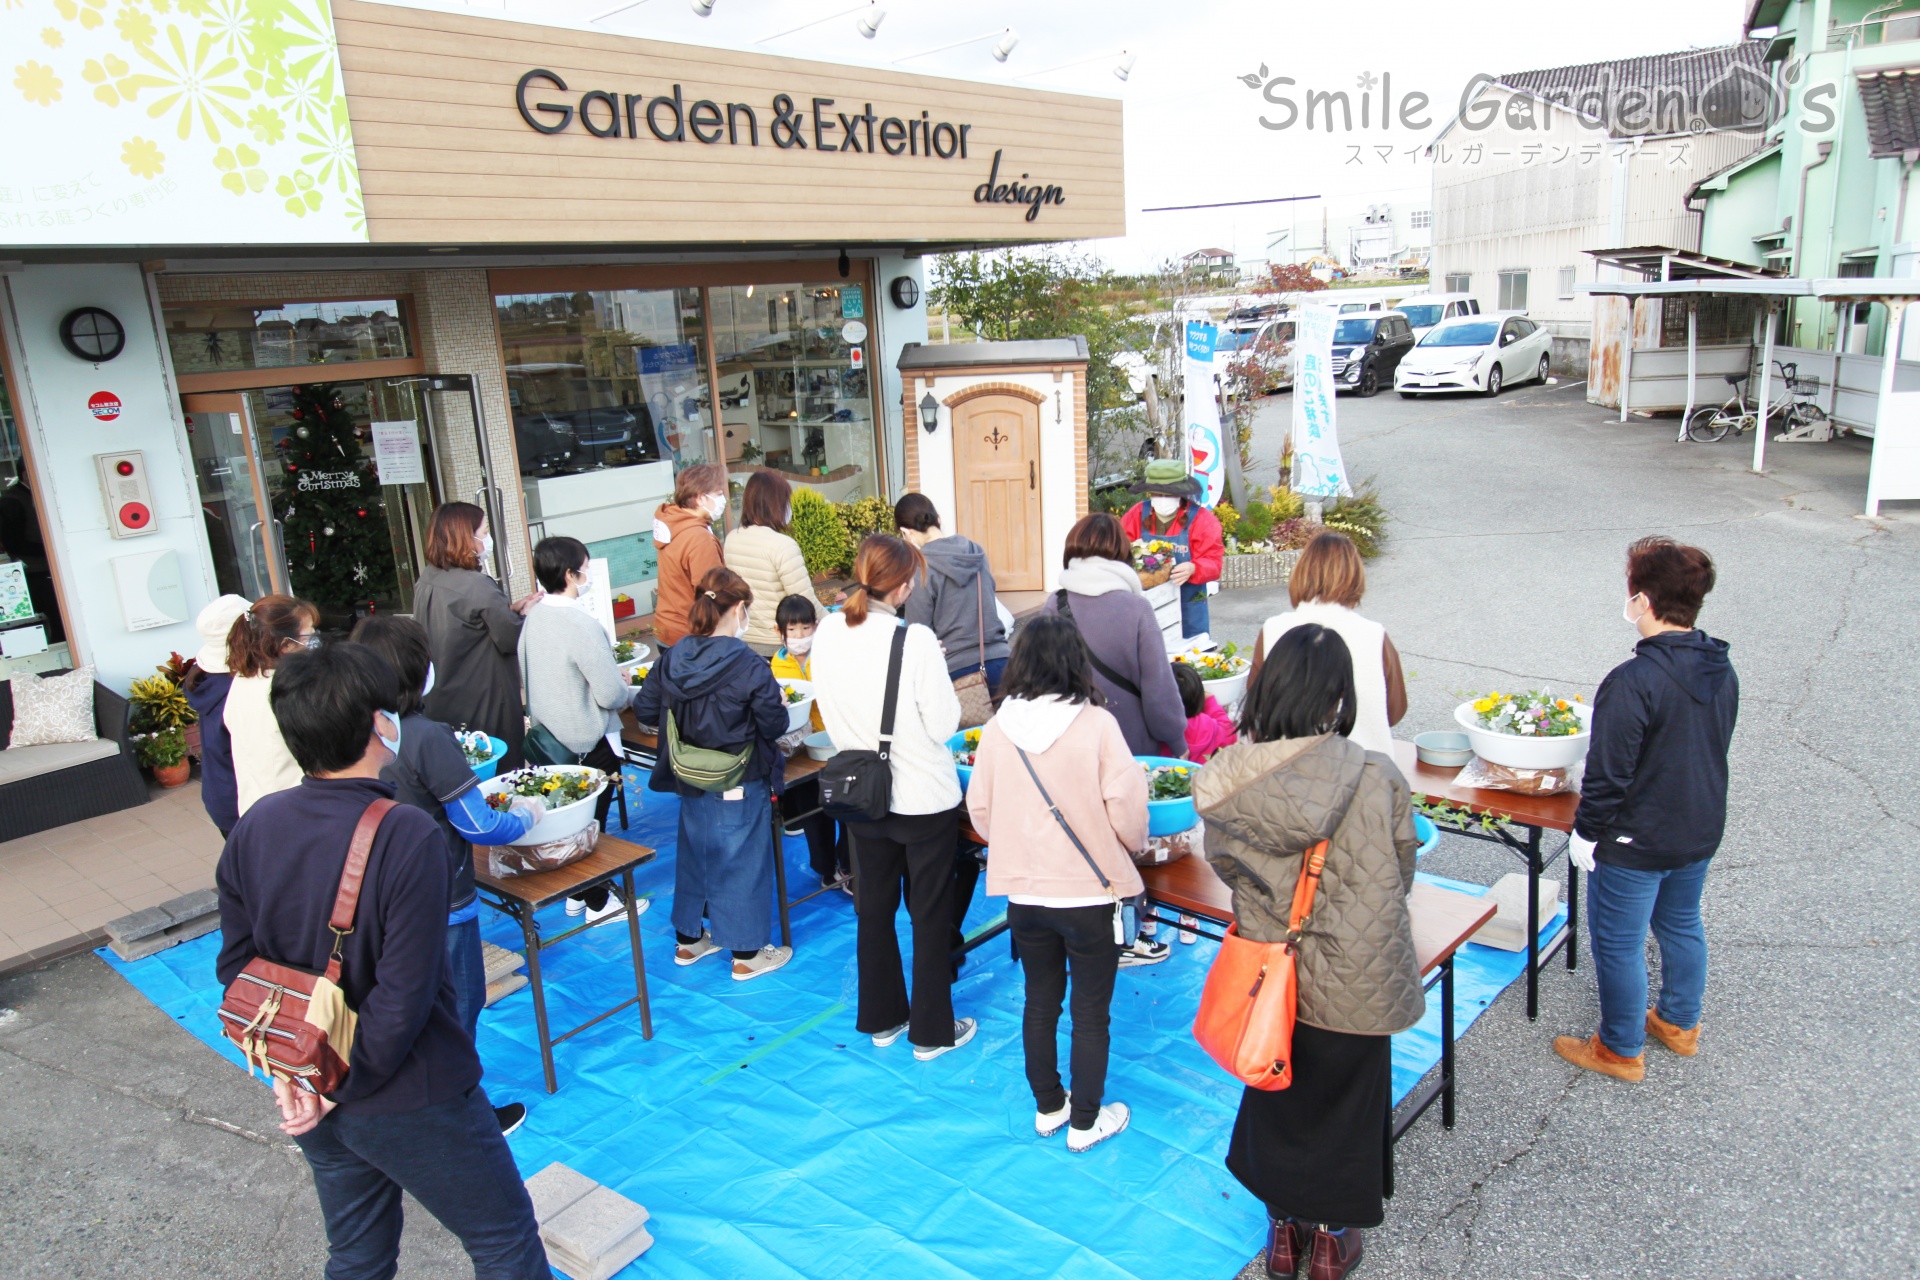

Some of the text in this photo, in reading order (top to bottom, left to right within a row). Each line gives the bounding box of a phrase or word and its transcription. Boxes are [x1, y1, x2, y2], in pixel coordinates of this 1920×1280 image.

[515, 68, 759, 147] Garden
[812, 97, 972, 159] Exterior
[974, 149, 1066, 222] design
[91, 407, 121, 416] SECOM
[310, 470, 348, 481] Merry
[298, 478, 361, 491] Christmas
